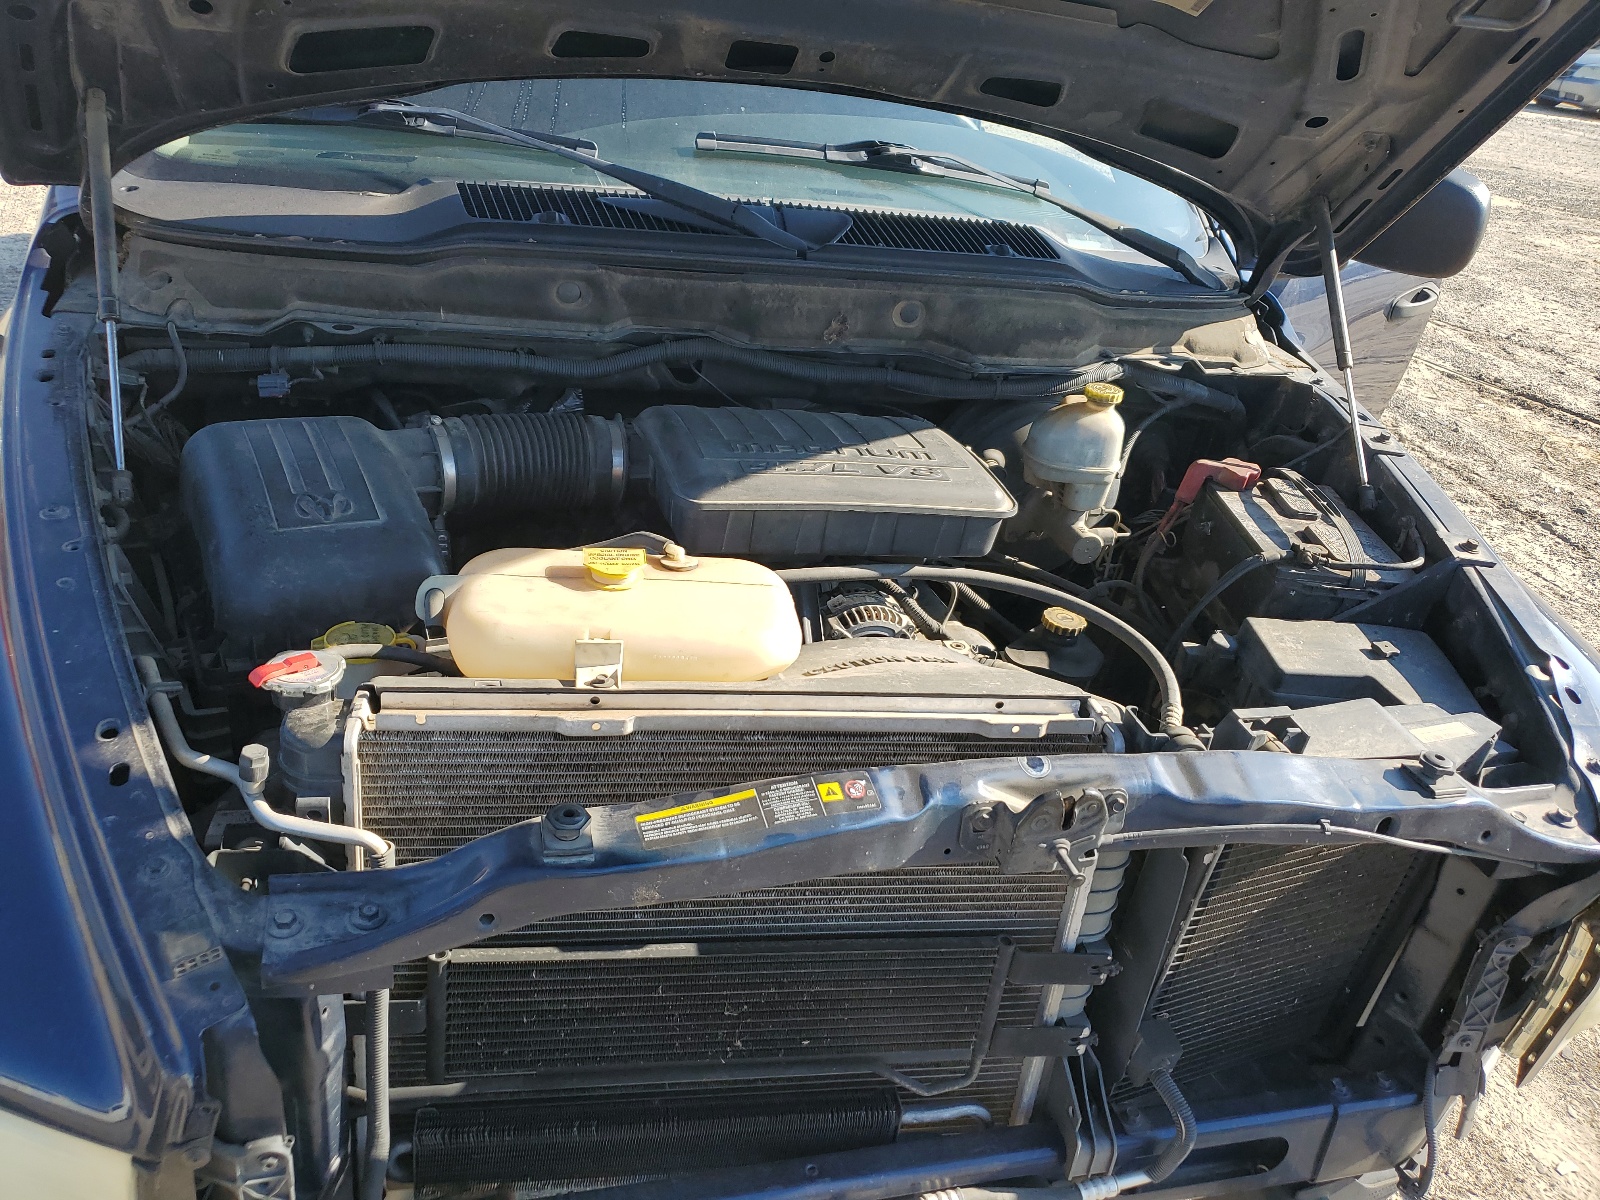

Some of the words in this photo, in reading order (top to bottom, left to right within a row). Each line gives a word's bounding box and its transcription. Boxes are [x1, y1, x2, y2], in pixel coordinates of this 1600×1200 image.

[876, 464, 944, 478] V8
[905, 655, 959, 664] FAN
[685, 801, 714, 809] WARNING
